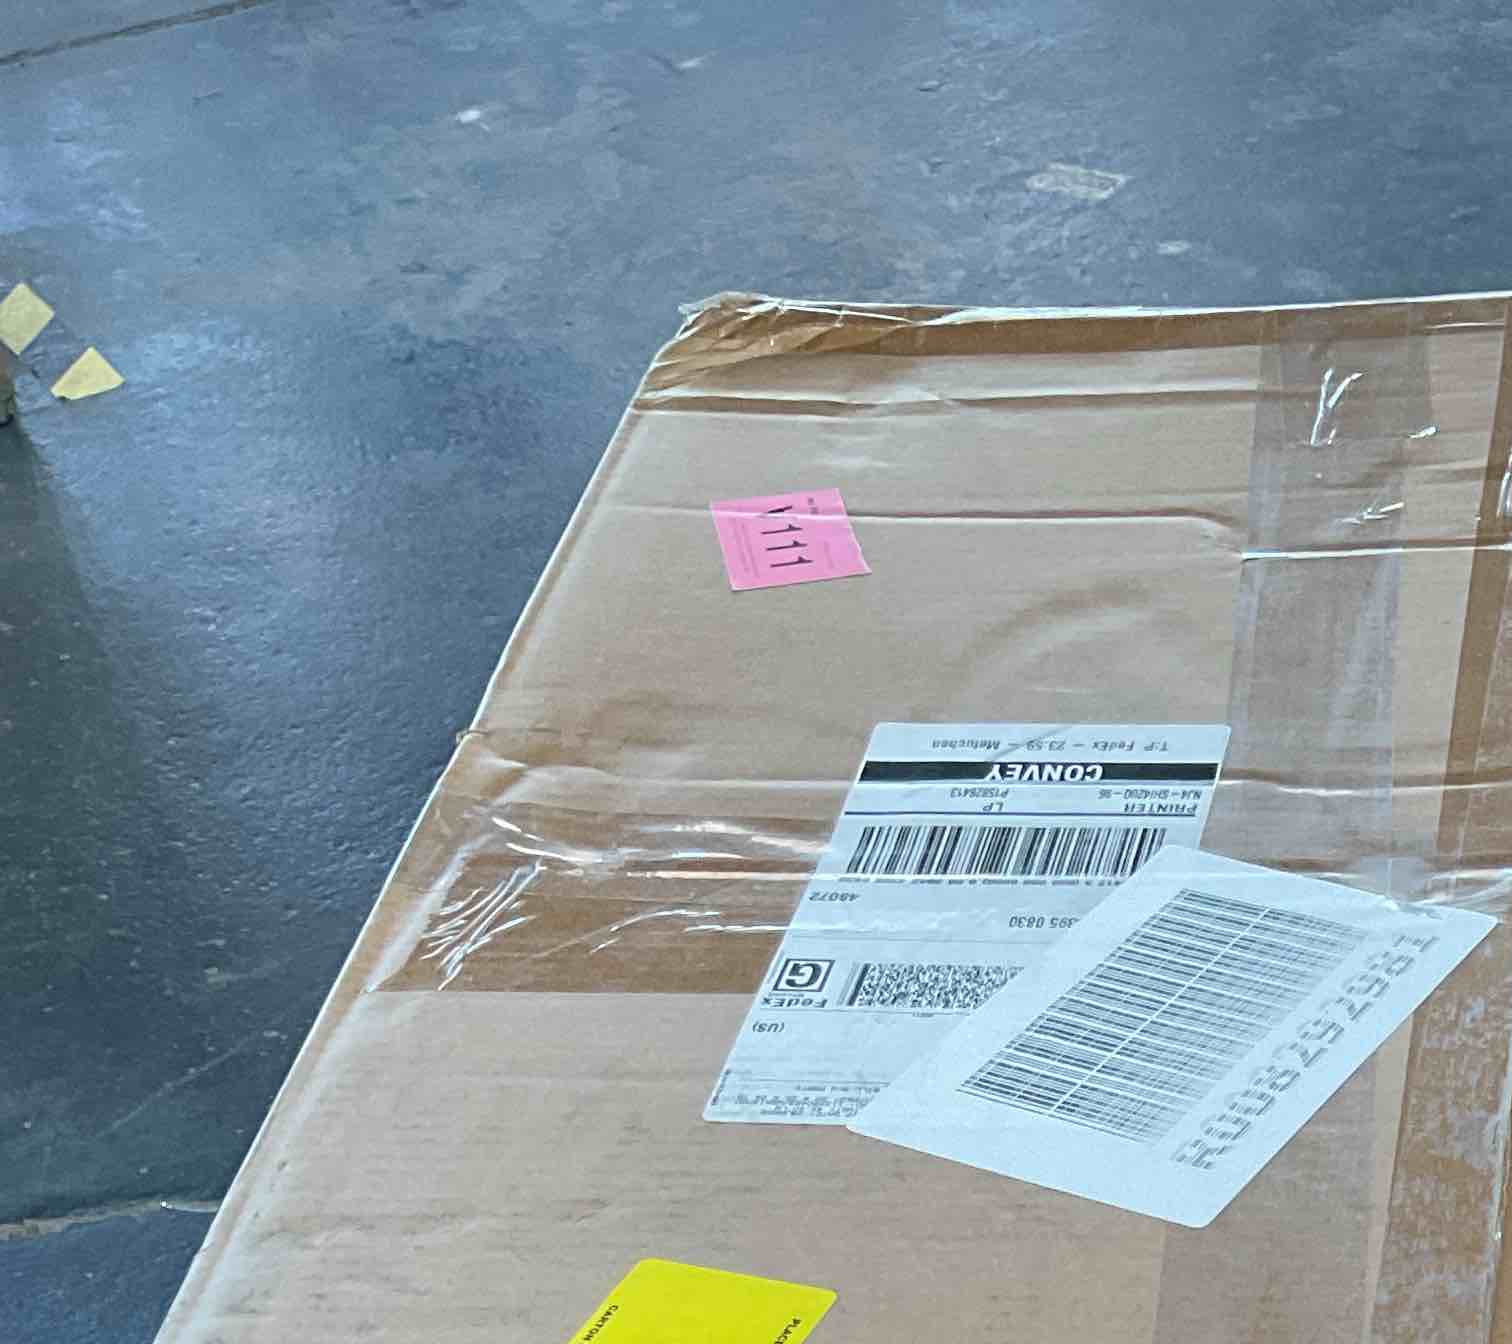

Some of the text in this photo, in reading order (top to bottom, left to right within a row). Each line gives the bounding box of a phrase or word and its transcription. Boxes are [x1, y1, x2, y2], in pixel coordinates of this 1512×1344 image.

[986, 763, 1104, 782] CONVEY
[982, 801, 1004, 812] LP
[1123, 801, 1198, 813] PRINTER
[1008, 916, 1044, 929] 0830
[785, 962, 822, 988] G
[761, 997, 828, 1009] FedEx
[752, 1021, 785, 1033] (US)
[583, 1304, 619, 1341] CARTON
